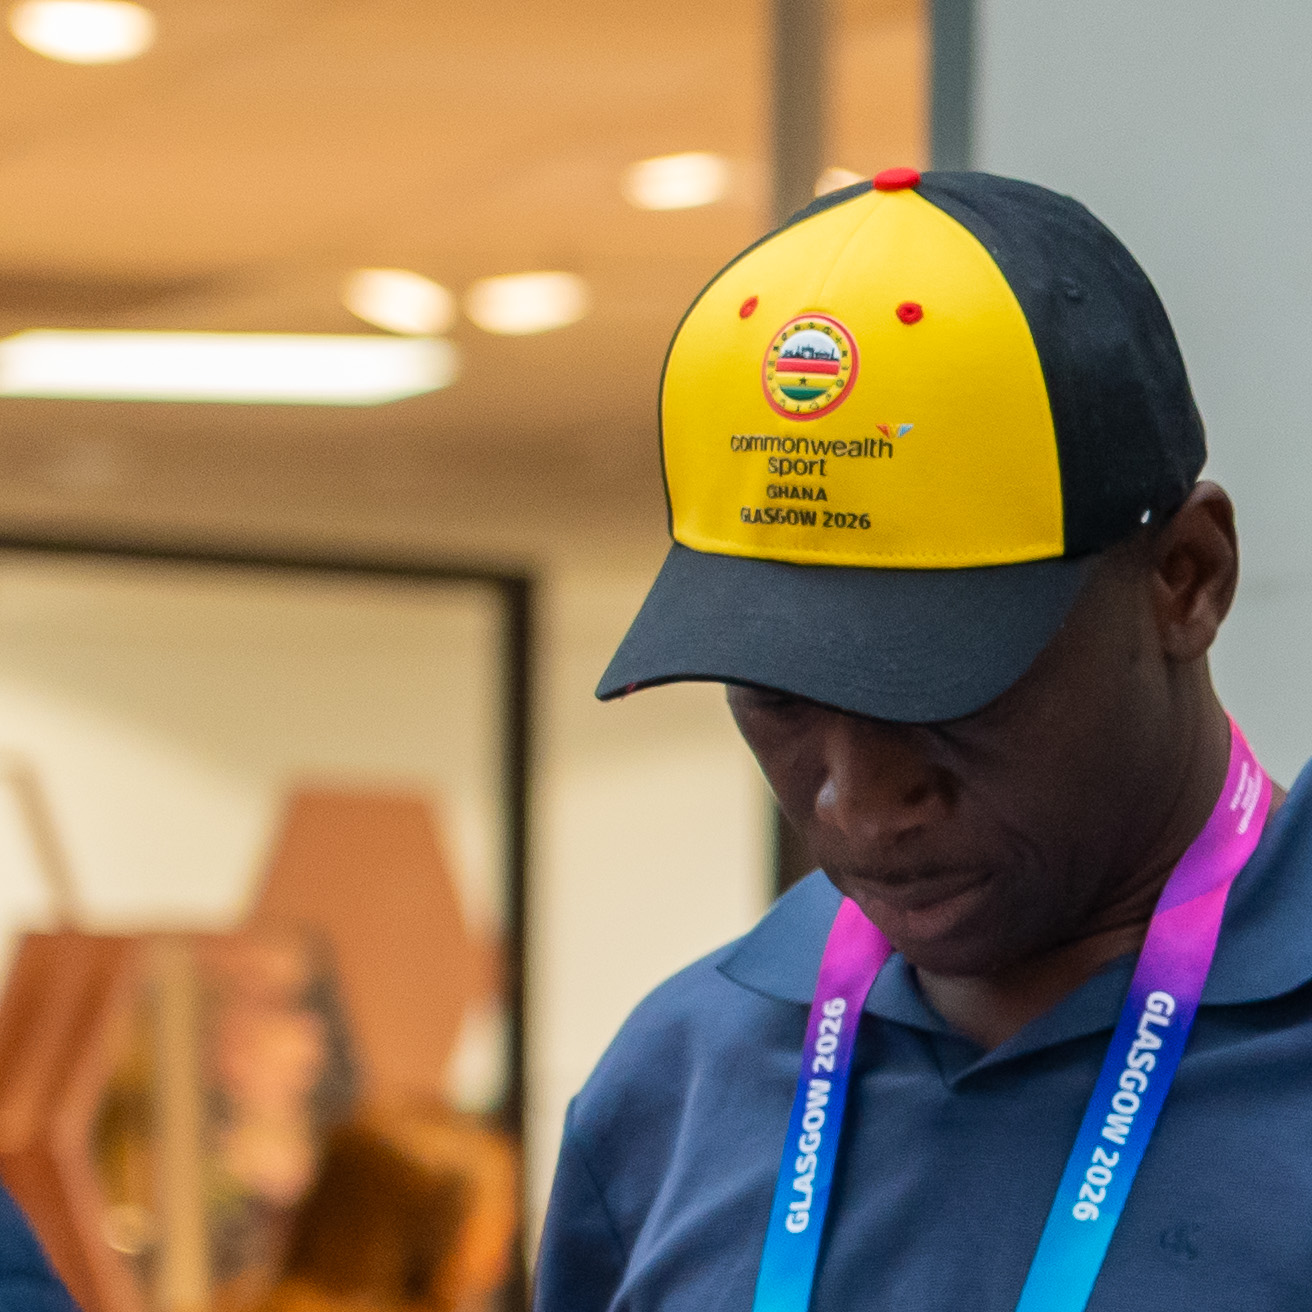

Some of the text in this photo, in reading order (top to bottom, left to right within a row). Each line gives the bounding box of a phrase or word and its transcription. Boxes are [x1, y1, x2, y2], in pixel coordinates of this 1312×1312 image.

[730, 434, 893, 459] commonwealth
[768, 456, 827, 477] sport
[766, 484, 828, 502] GHANA
[740, 506, 872, 530] GLASGOW 2026
[785, 997, 847, 1234] GLASGOW 2026
[1071, 990, 1176, 1222] GLASGOW 2026
